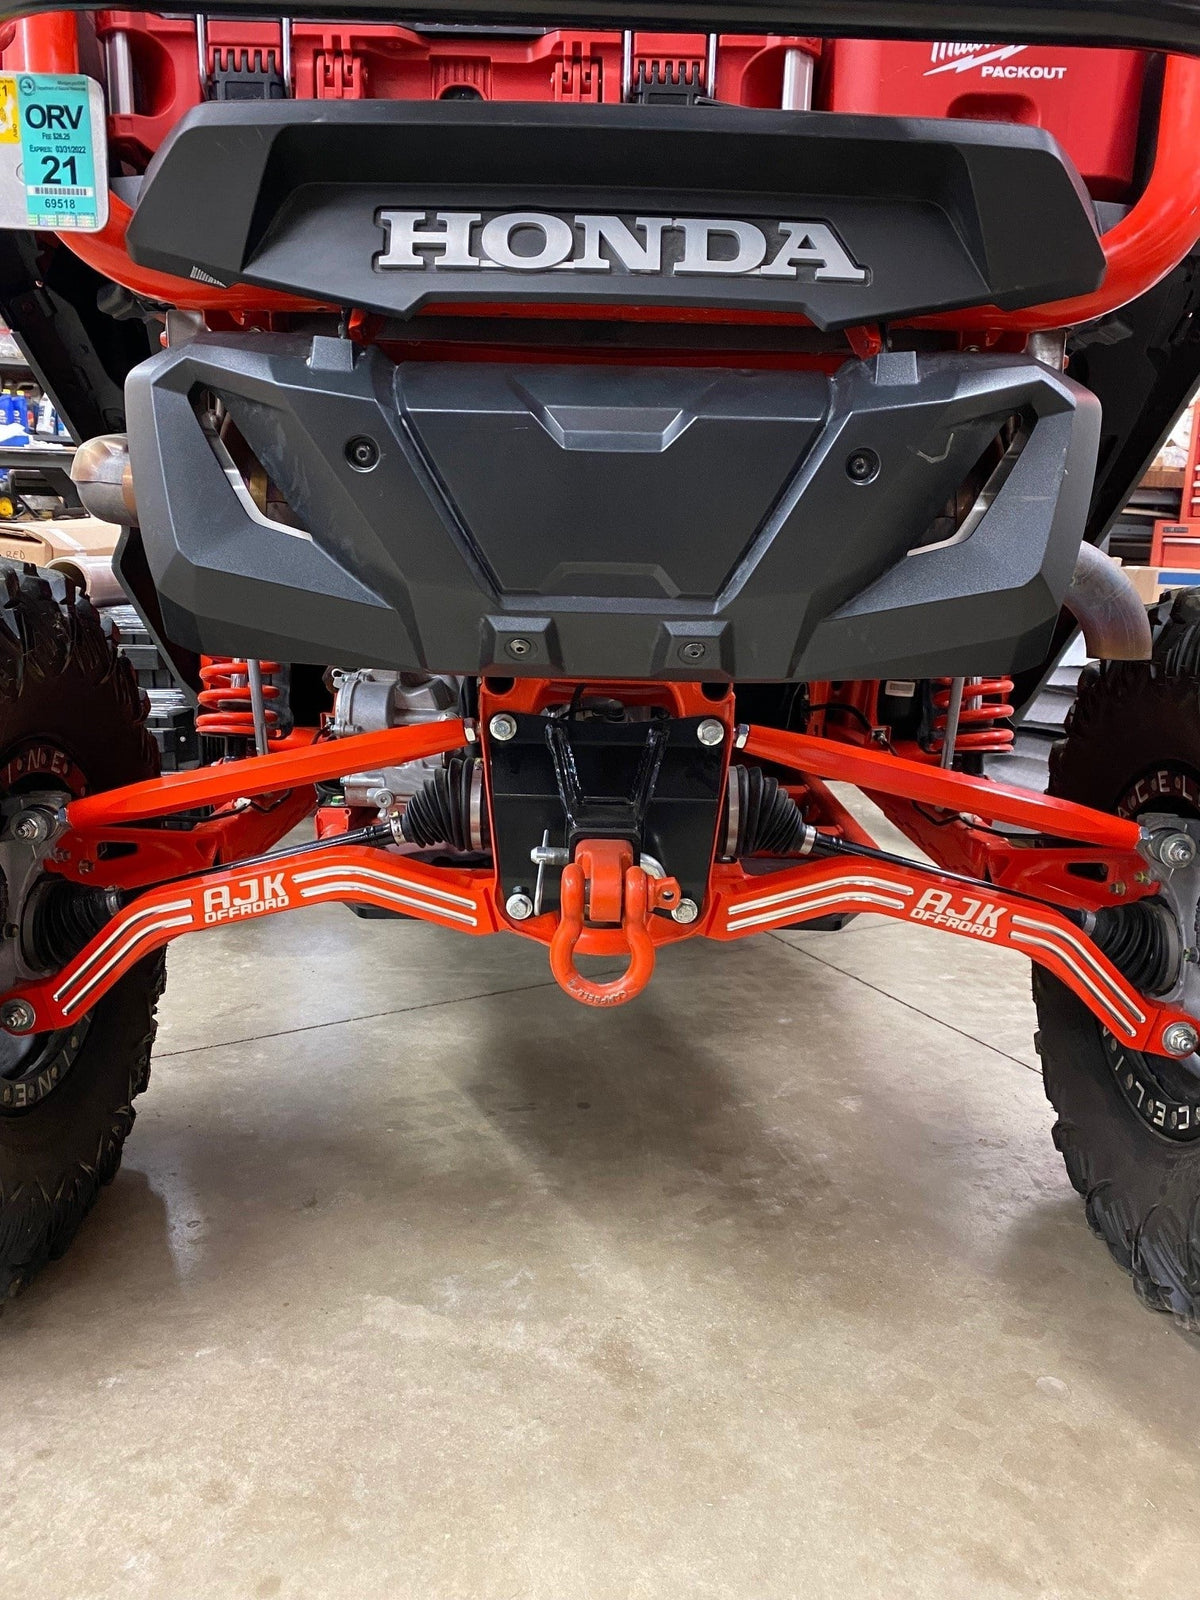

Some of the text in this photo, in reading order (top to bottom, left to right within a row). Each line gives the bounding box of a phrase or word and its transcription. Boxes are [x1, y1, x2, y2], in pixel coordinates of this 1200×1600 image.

[981, 65, 1067, 79] PACKOUT
[25, 104, 83, 129] ORV
[41, 155, 77, 185] 21
[45, 199, 75, 209] 69518
[378, 211, 866, 281] HONDA
[6, 550, 25, 560] RED
[203, 872, 287, 913] AJK
[204, 895, 289, 923] OFFROAD
[916, 888, 1008, 928] AJK
[910, 908, 997, 938] OFFROAD
